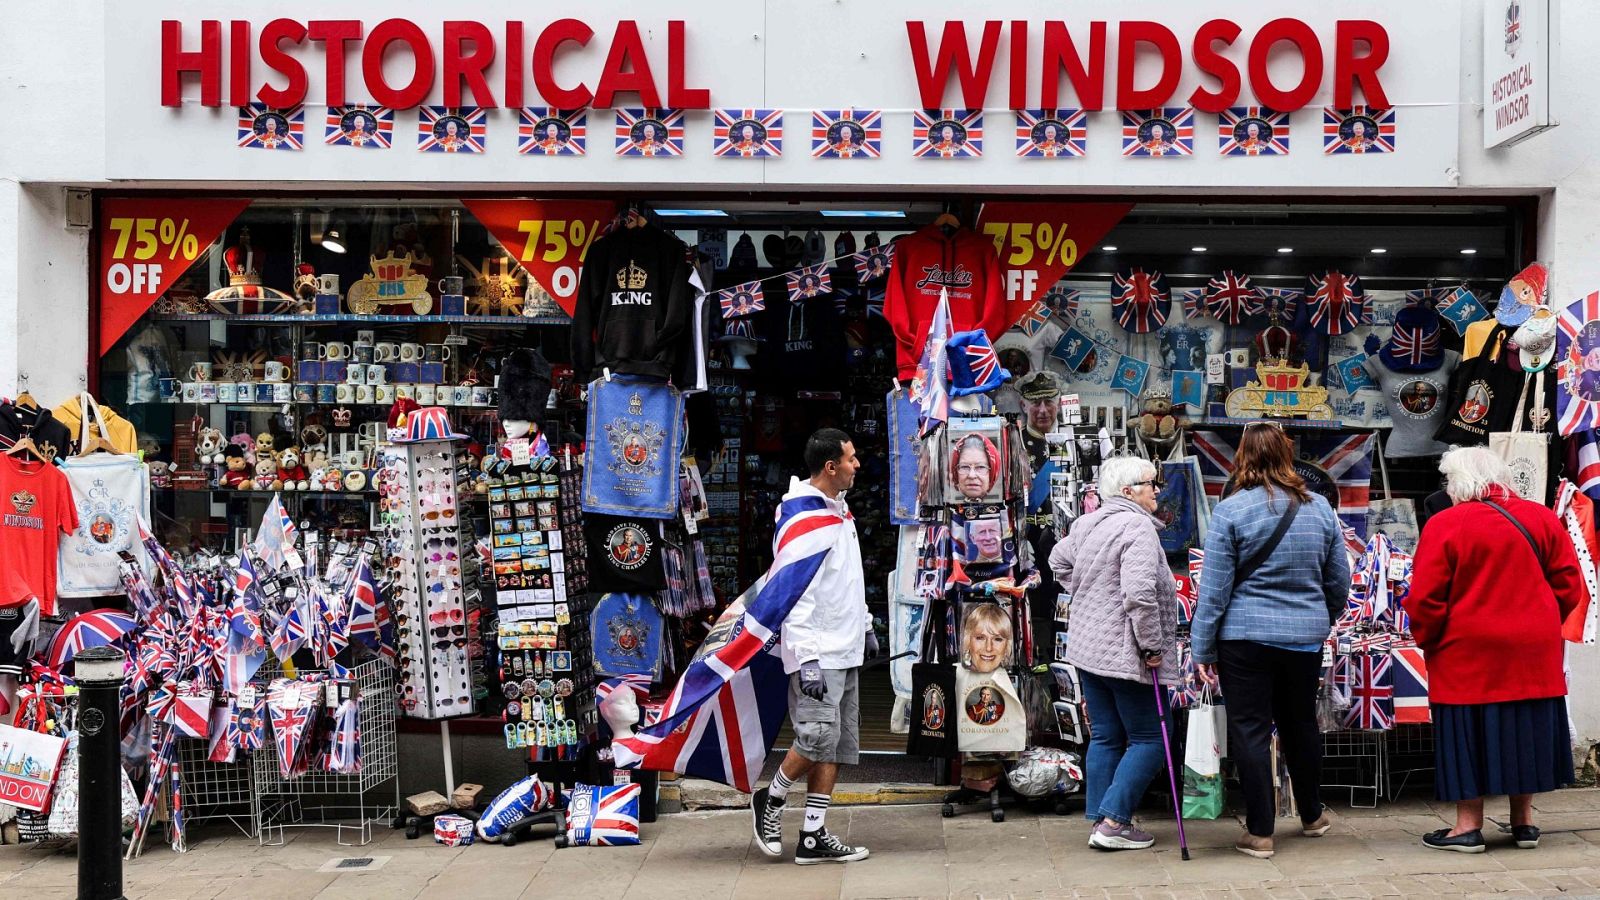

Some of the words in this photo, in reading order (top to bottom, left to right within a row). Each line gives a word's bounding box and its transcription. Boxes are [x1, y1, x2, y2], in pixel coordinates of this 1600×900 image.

[161, 18, 709, 109] HISTORICAL
[906, 17, 1392, 112] WINDSOR
[1492, 62, 1533, 104] HISTORICAL
[1495, 94, 1529, 131] WINDSOR
[109, 217, 199, 261] 75%
[983, 222, 1077, 266] 75%
[107, 262, 163, 294] OFF
[915, 263, 973, 290] London
[1001, 269, 1038, 301] FF
[611, 292, 652, 306] KING
[785, 340, 813, 352] KING
[3, 513, 44, 530] WINDSOR
[613, 522, 627, 532] SAVE
[621, 557, 648, 570] CHARLES
